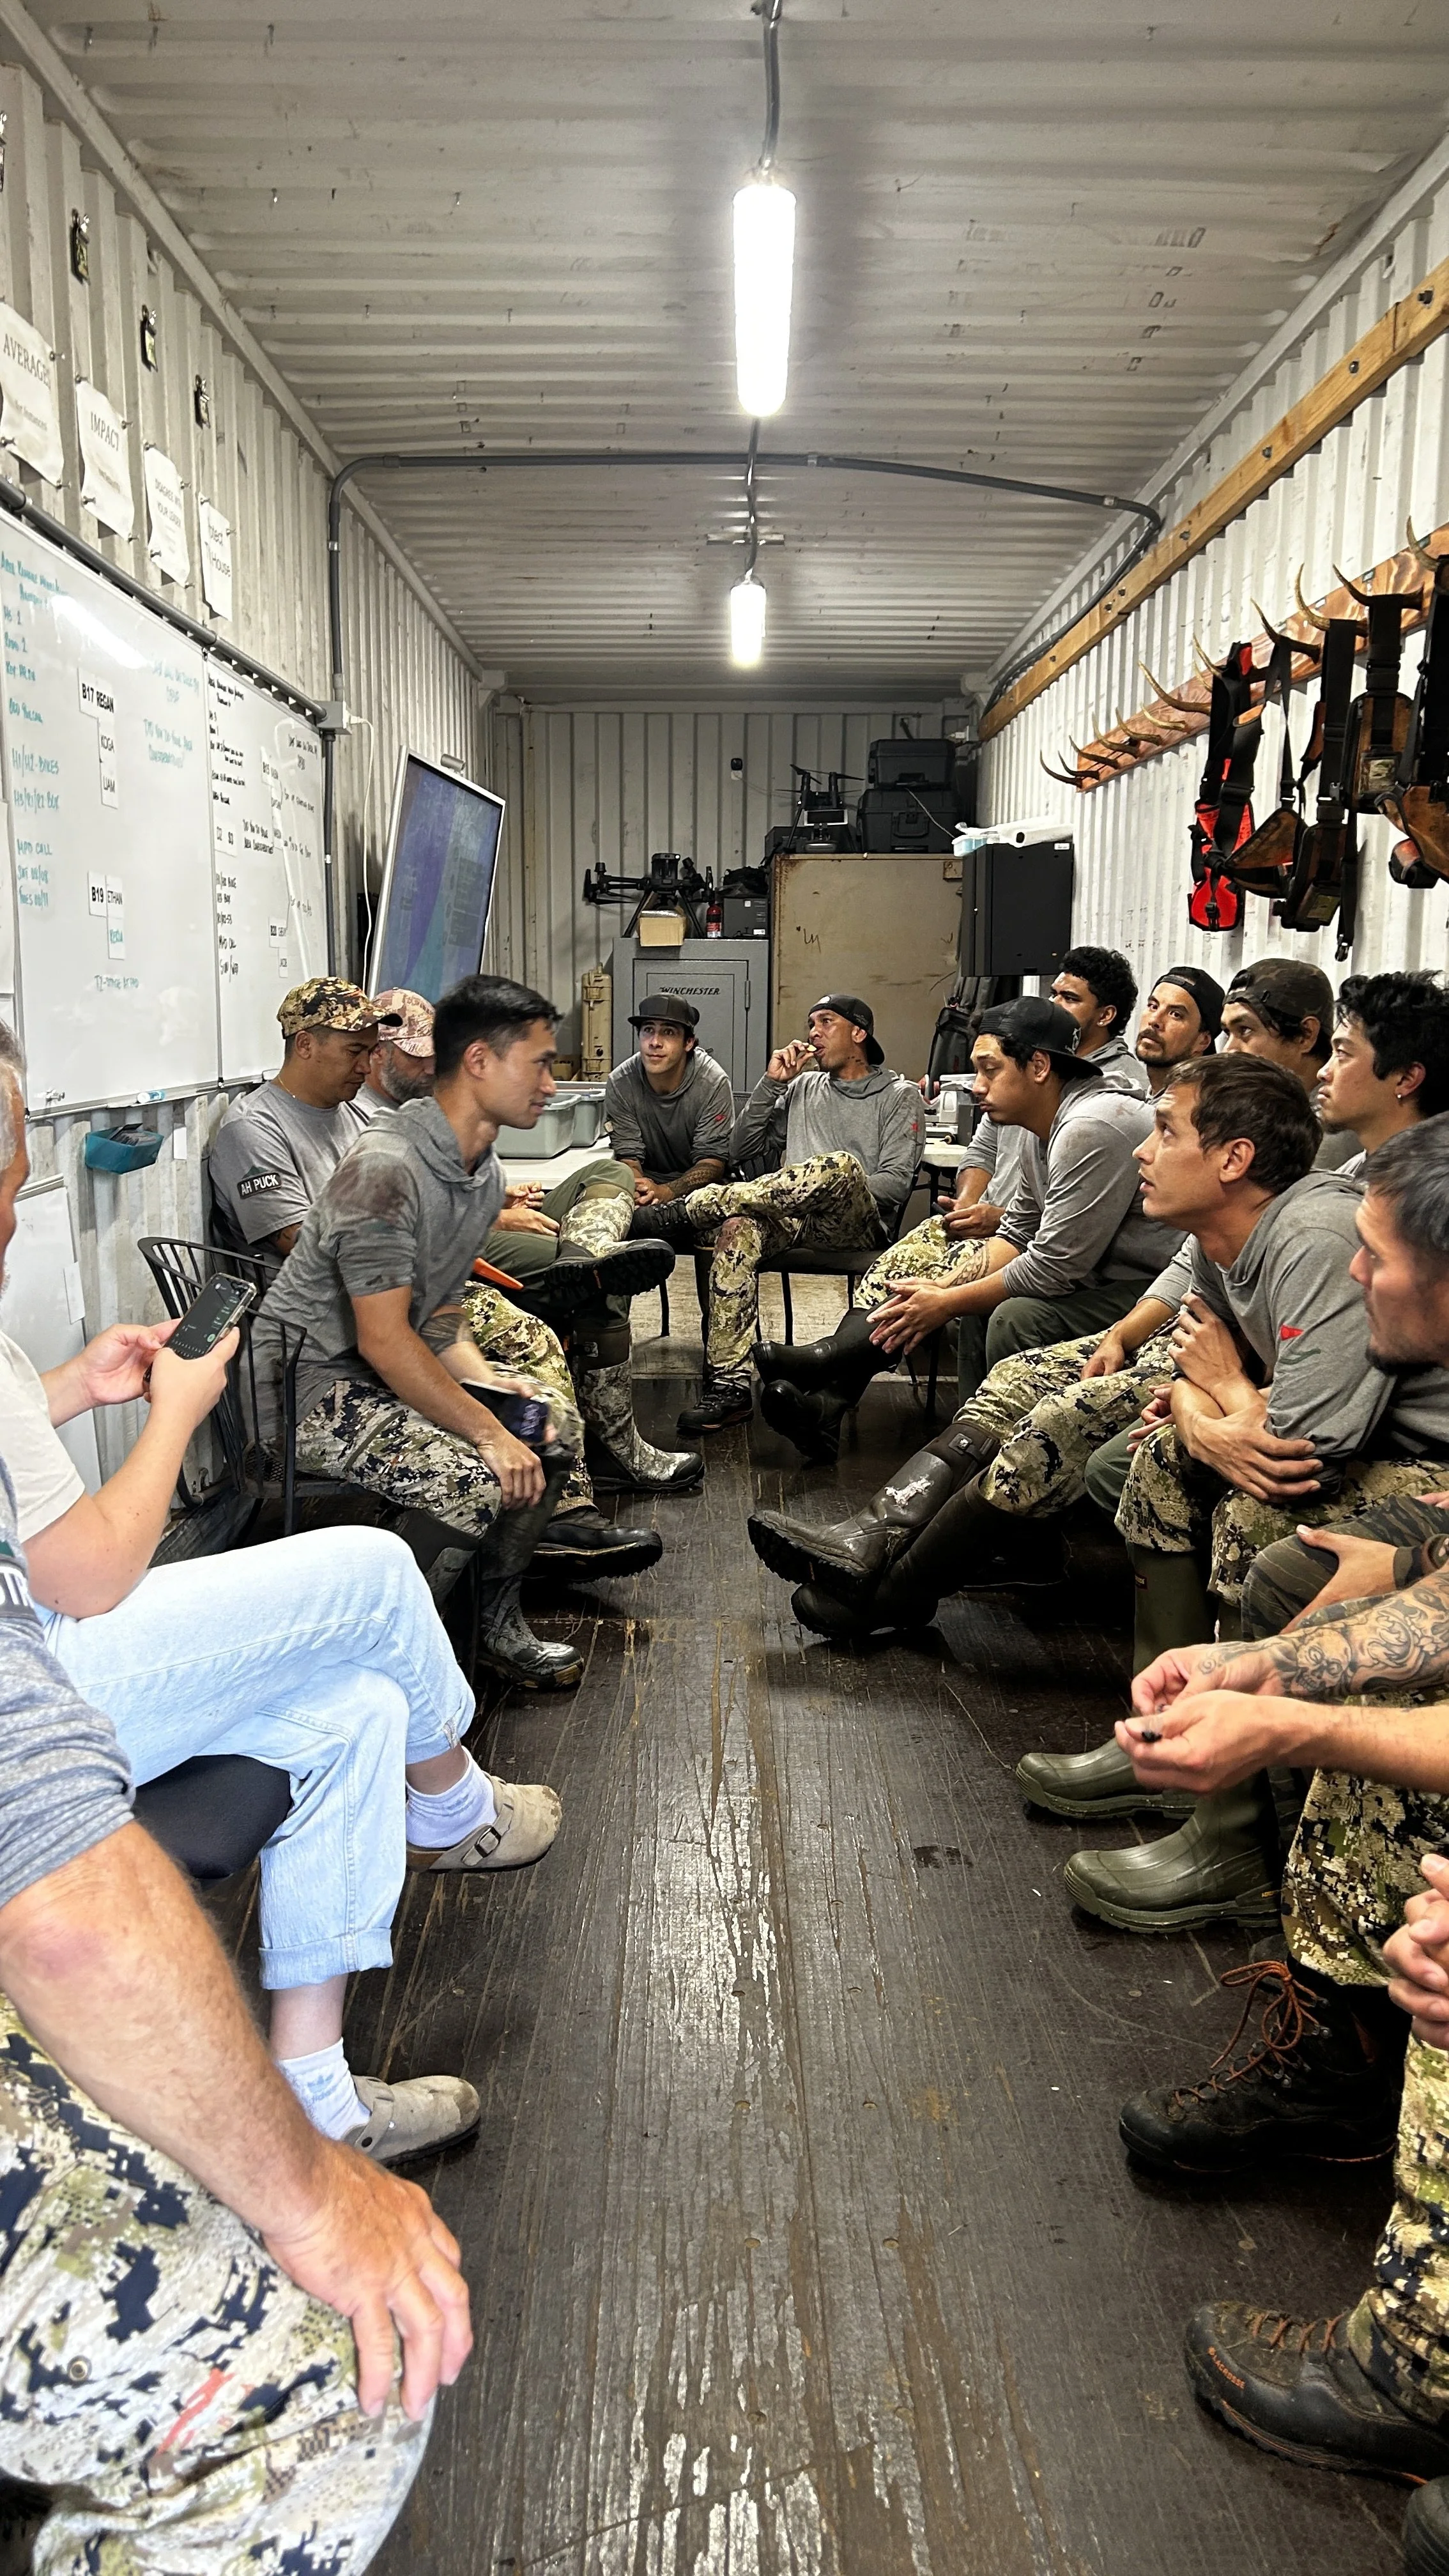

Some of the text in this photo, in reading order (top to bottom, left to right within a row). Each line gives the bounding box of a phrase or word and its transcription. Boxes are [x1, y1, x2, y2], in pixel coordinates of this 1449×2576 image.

[91, 411, 119, 451] IMPACT
[81, 682, 95, 703] B17
[91, 886, 123, 905] B19 ETHAN
[659, 986, 720, 995] WINCHESTER
[240, 1174, 280, 1197] AH PUCK
[1211, 2354, 1246, 2390] LACROSSE
